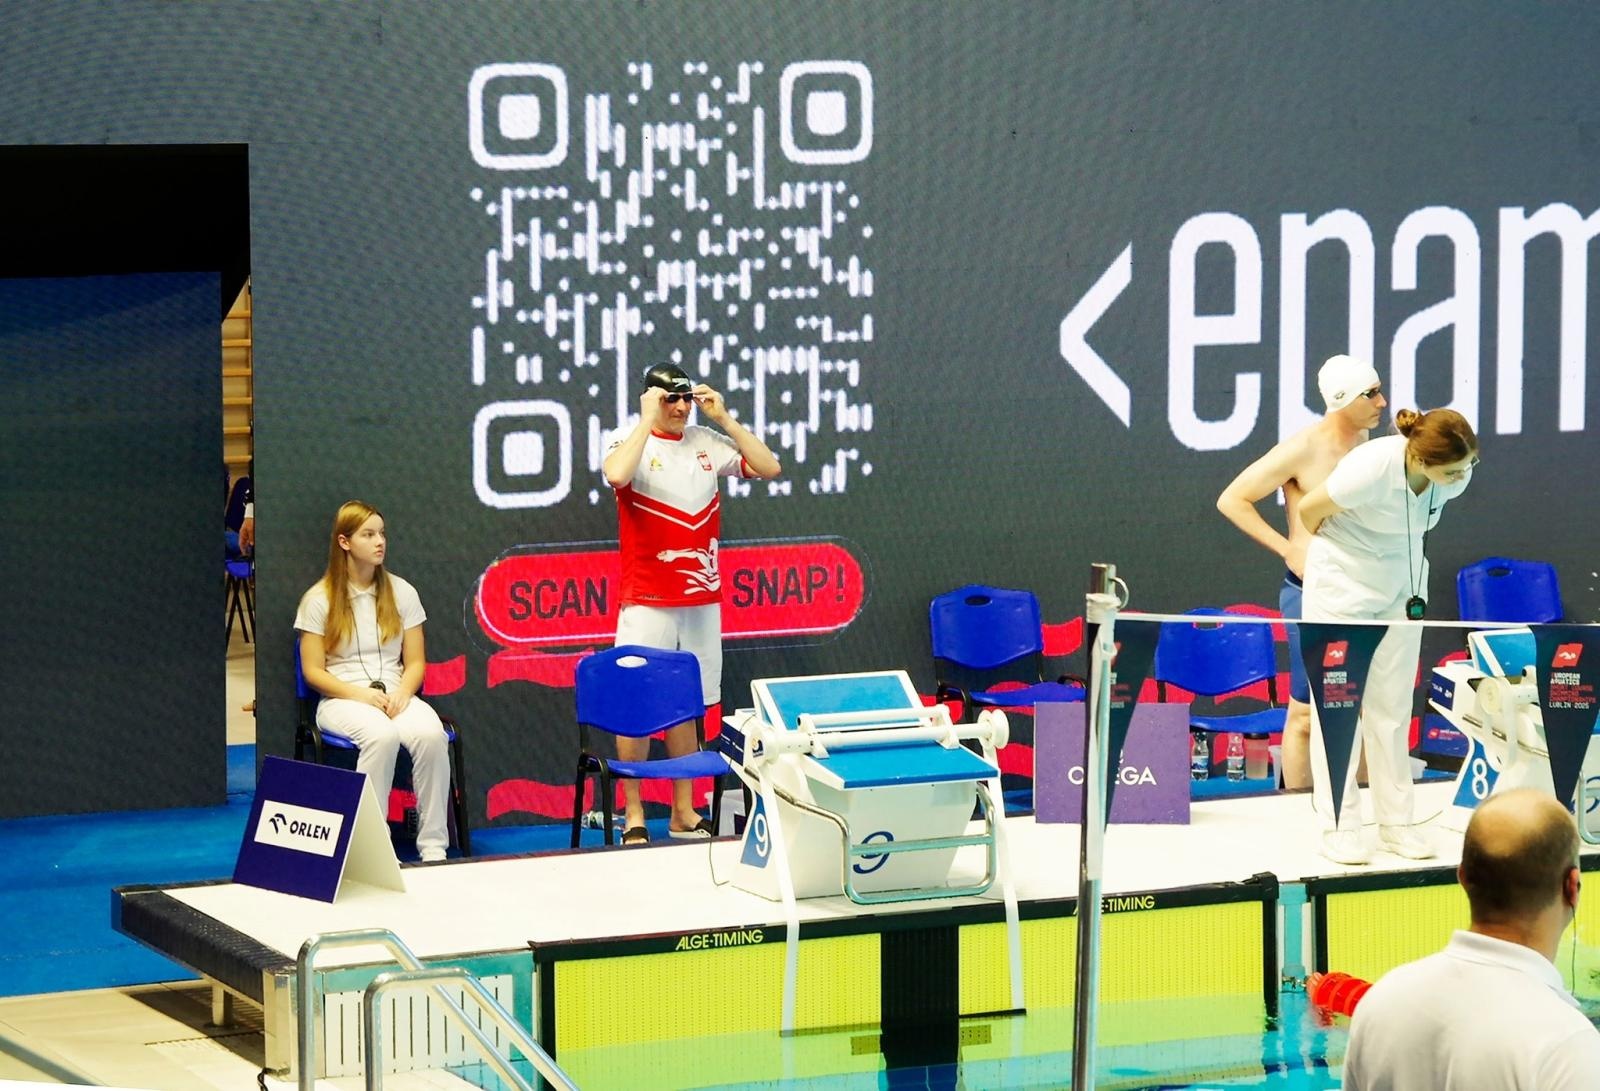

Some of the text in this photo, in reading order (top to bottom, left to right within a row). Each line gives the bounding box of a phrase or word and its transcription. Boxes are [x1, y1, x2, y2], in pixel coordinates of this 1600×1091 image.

[509, 577, 608, 621] SCAN
[1068, 766, 1157, 785] OGA
[1471, 757, 1489, 800] 8
[289, 820, 331, 841] ORLEN
[754, 813, 769, 858] 9
[675, 929, 764, 951] ALGE-TIMING
